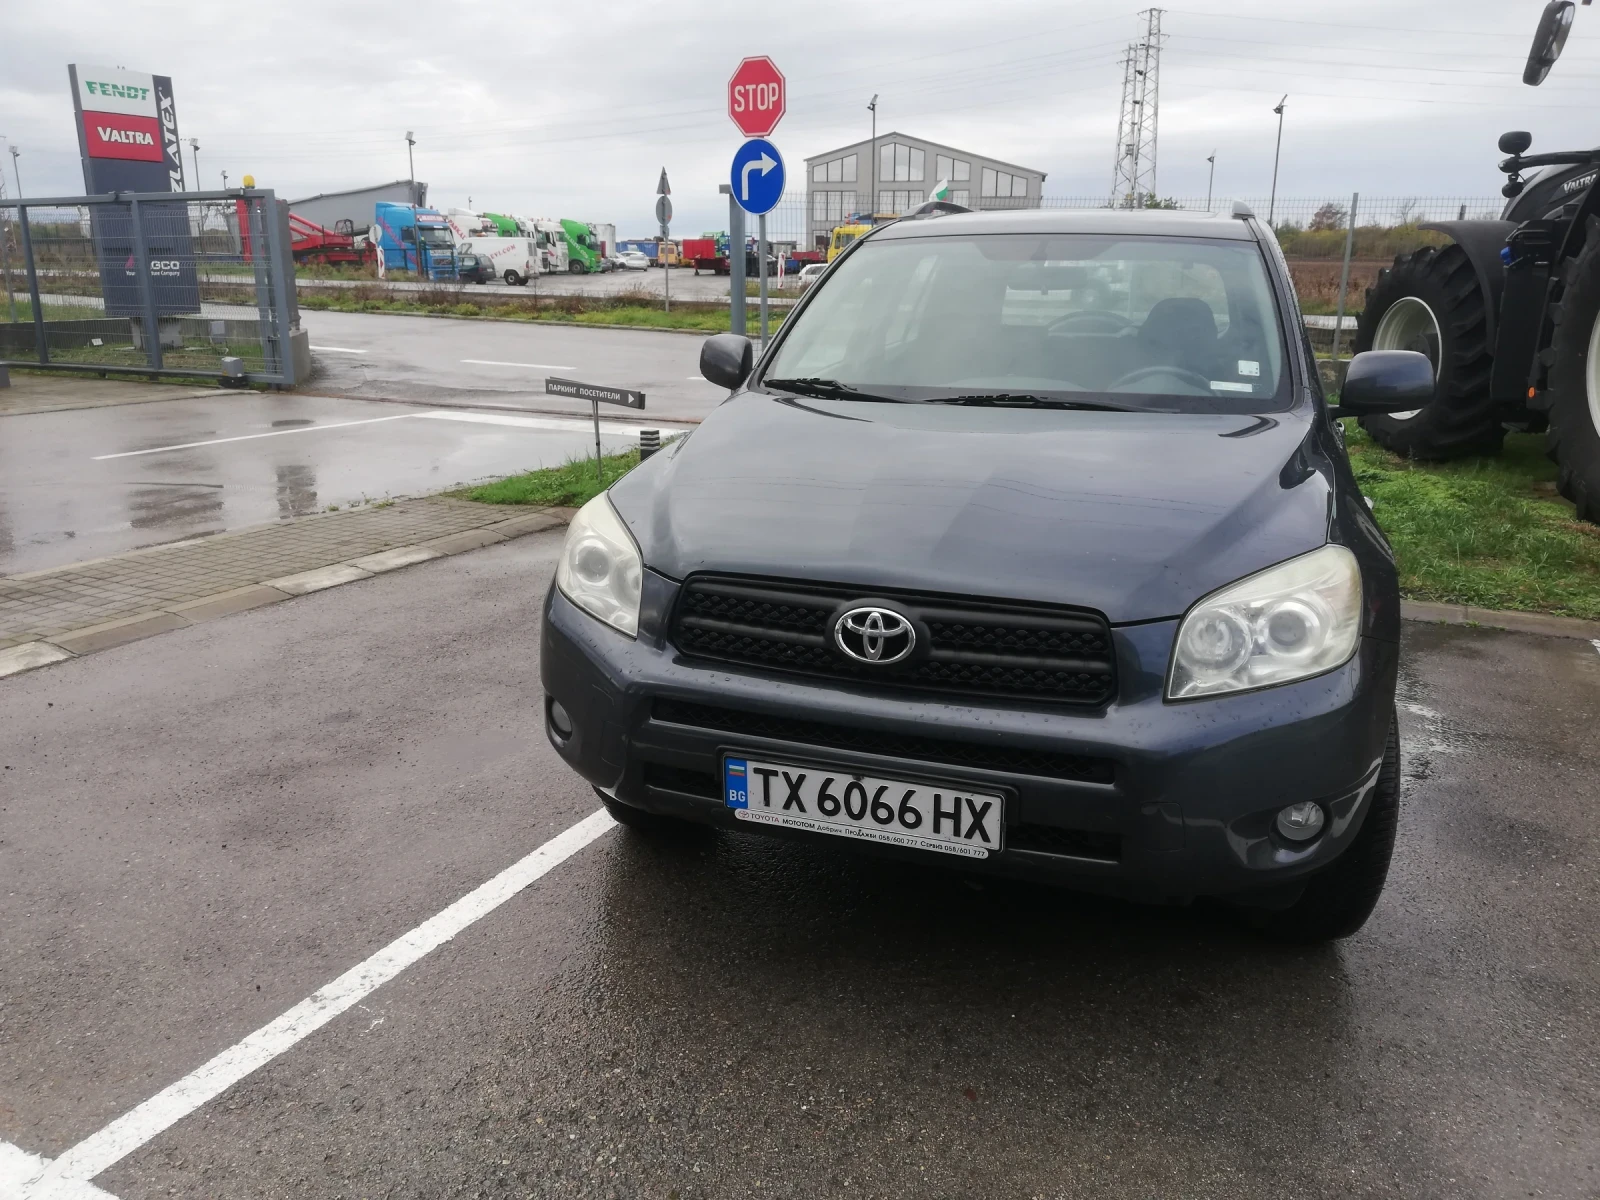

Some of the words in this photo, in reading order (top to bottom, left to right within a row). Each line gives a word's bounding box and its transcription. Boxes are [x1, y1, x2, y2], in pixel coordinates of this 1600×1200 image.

[85, 81, 150, 101] FENDT
[734, 82, 779, 112] STOP
[97, 126, 154, 145] VALTRA
[548, 383, 577, 395] ПАРКИНГ
[579, 387, 621, 401] ПОСЕТИТЕЛИ
[729, 789, 746, 802] BG
[750, 813, 780, 823] TOYOTA
